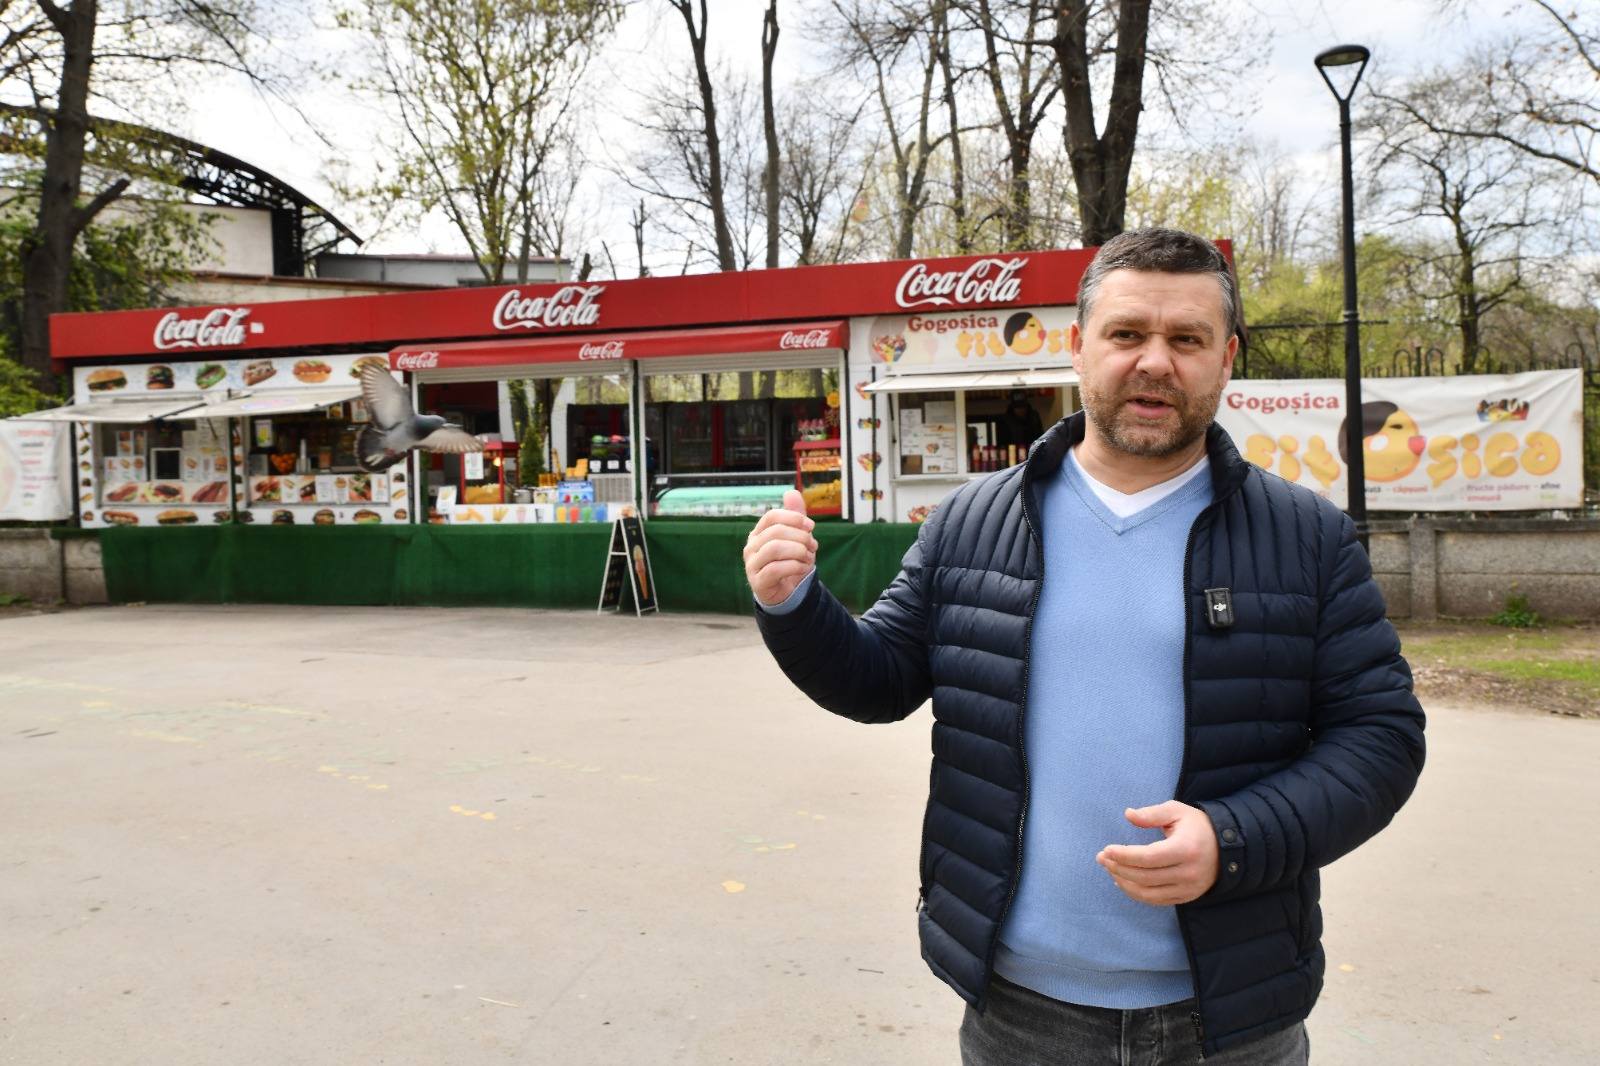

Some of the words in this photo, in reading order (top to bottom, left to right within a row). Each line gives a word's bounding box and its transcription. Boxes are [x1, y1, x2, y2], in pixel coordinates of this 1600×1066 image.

[895, 257, 1029, 308] Coca-Cola
[493, 285, 606, 330] Coca-Cola
[153, 308, 252, 349] Coca-Cola
[780, 329, 831, 349] Coca-Cola
[579, 341, 625, 360] Coca-Cola
